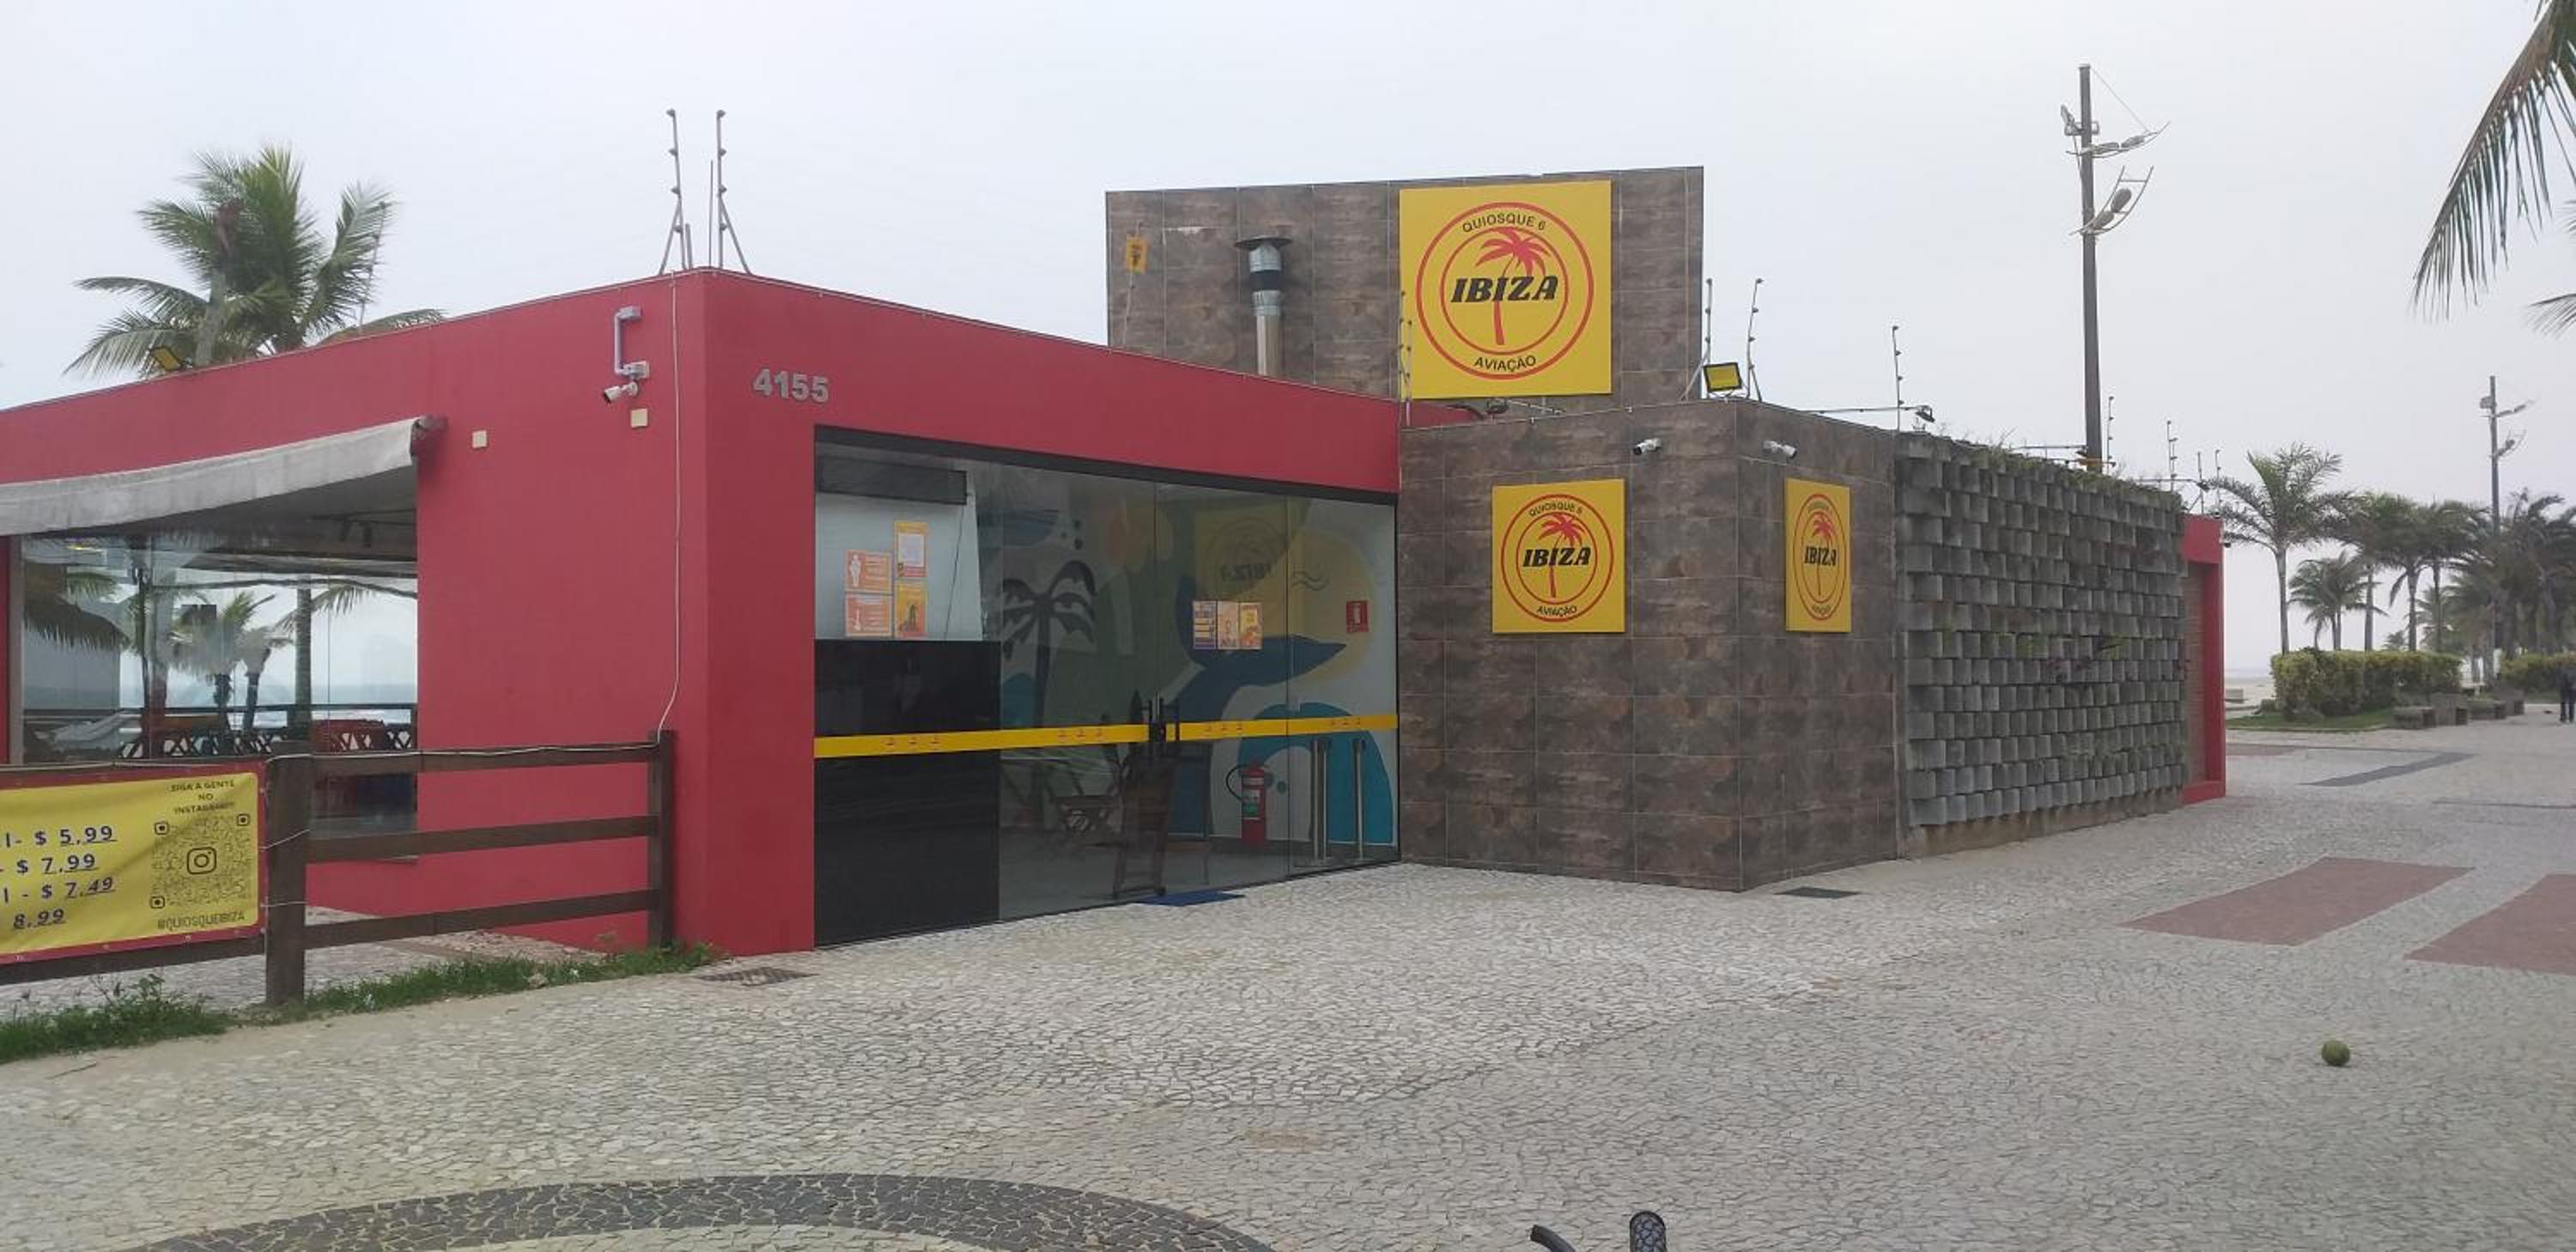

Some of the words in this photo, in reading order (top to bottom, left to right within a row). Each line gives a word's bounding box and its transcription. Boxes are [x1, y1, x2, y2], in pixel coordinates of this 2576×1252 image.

[1462, 212, 1537, 233] QUIOSQUE
[1539, 220, 1546, 231] 6
[1451, 275, 1559, 303] IBIZA
[1474, 354, 1537, 374] AVIAÇÃO
[753, 368, 829, 404] 4155
[1528, 501, 1576, 518] QUIOSQUE
[1522, 546, 1591, 568] IBIZA
[1804, 544, 1838, 567] IBIZA
[1536, 604, 1578, 617] AVIAÇÃO
[204, 780, 234, 789] GENTE
[198, 793, 214, 801] NO
[33, 830, 48, 846] $
[15, 859, 29, 875] $
[40, 884, 53, 900] $
